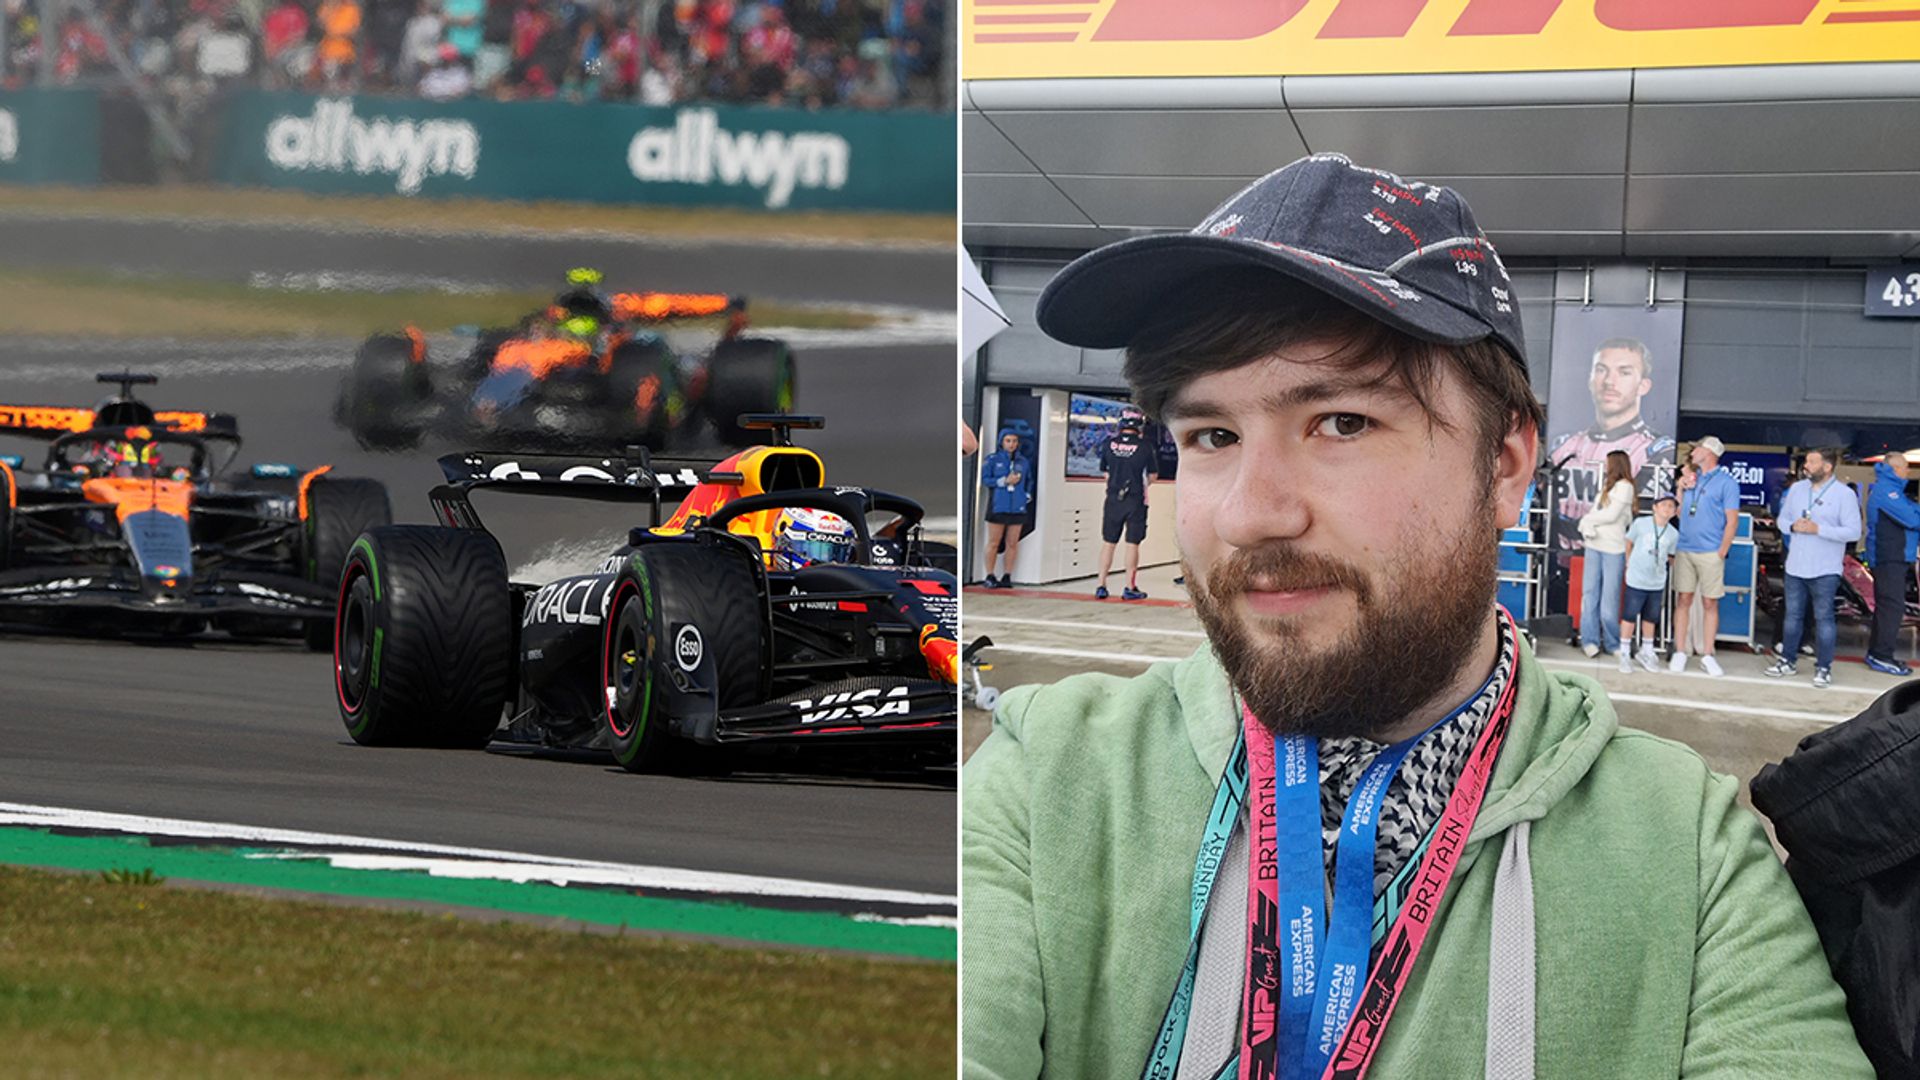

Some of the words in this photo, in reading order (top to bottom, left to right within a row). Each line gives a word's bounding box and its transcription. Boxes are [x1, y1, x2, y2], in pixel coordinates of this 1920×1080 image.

[266, 98, 479, 195] allwyn
[627, 107, 850, 208] allwyn
[1882, 272, 1920, 307] 43
[1555, 466, 1607, 503] BW
[790, 686, 910, 724] VISA
[1295, 733, 1307, 785] ERICAN
[1361, 762, 1392, 826] EXPRESS
[1258, 776, 1278, 881] BRITAIN
[1350, 763, 1384, 836] AMERICAN
[1194, 831, 1226, 911] SUNDAY
[1408, 817, 1465, 925] BRITAIN
[1253, 942, 1279, 990] Guest
[1290, 918, 1304, 998] EXPRESS
[1302, 905, 1315, 995] AMERICAN
[1250, 987, 1276, 1048] VIP
[1319, 962, 1345, 1056] AMERICAN
[1333, 963, 1357, 1044] EXPRESS
[1335, 1018, 1371, 1072] VIP
[1364, 977, 1394, 1026] Guest
[1149, 1018, 1178, 1080] DOCK
